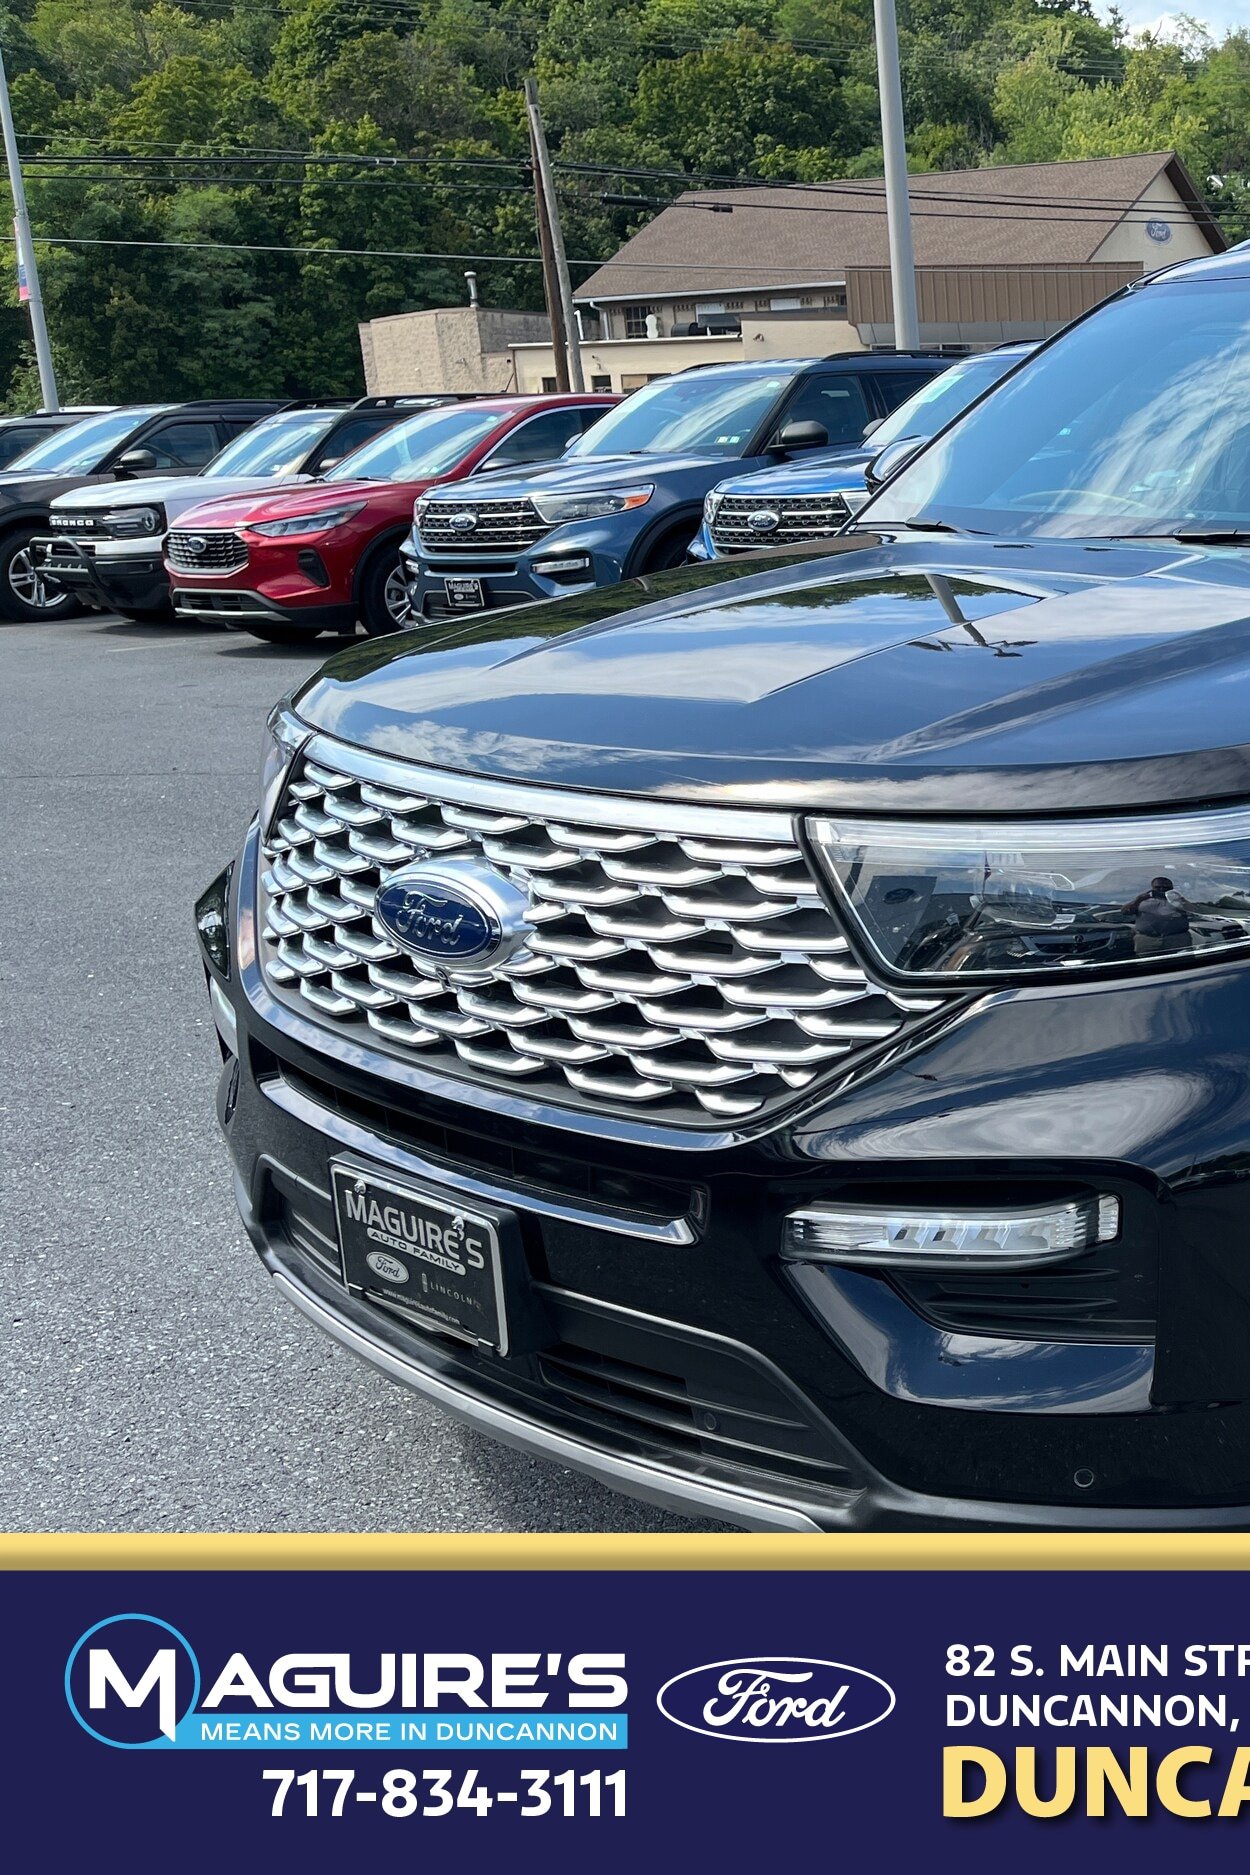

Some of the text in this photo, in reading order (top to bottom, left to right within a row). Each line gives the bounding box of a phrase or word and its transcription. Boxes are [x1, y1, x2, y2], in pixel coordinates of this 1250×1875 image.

[395, 890, 464, 946] Ford
[345, 1189, 485, 1269] MAGUIRE'S
[371, 1230, 461, 1272] AUTO FAMILY
[375, 1255, 473, 1305] Ford LINCOLN
